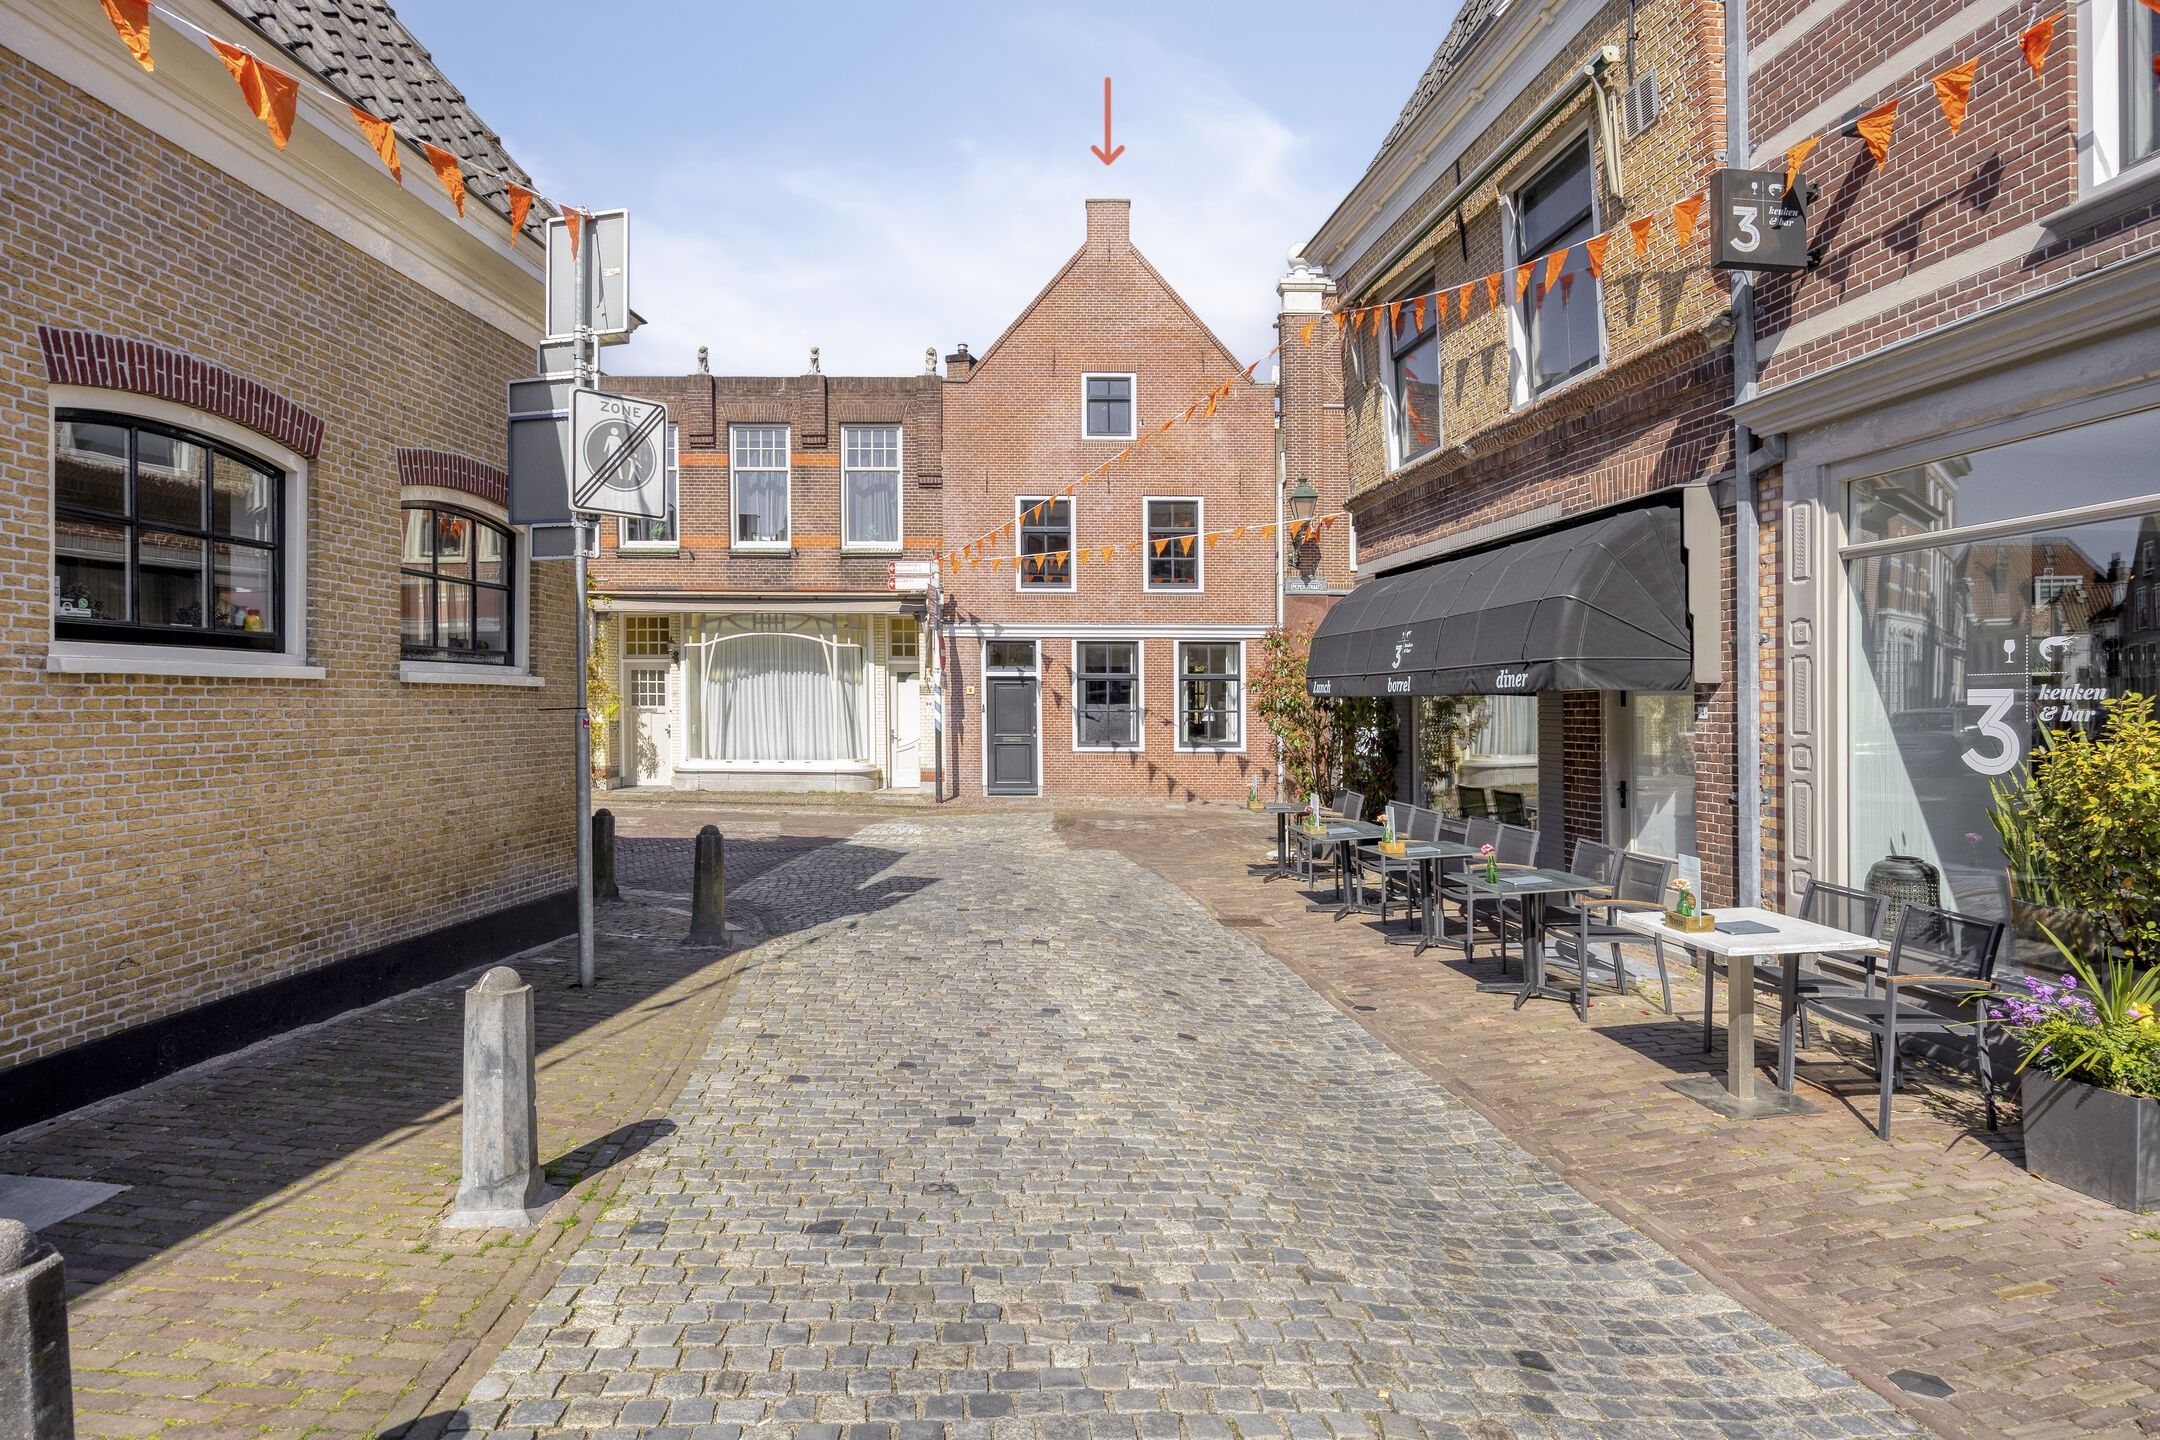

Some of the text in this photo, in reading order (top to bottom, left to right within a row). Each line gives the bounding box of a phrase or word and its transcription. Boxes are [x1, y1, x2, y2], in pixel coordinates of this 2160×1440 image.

[1769, 206, 1798, 216] keuken
[1730, 206, 1760, 252] 3
[1779, 218, 1794, 226] bar
[600, 400, 641, 418] ZONE
[1392, 644, 1403, 669] 3
[1387, 676, 1411, 692] borrel
[1496, 668, 1528, 688] diner
[2038, 683, 2107, 700] keuken
[2039, 705, 2096, 722] & bar
[1961, 688, 2020, 775] 3
